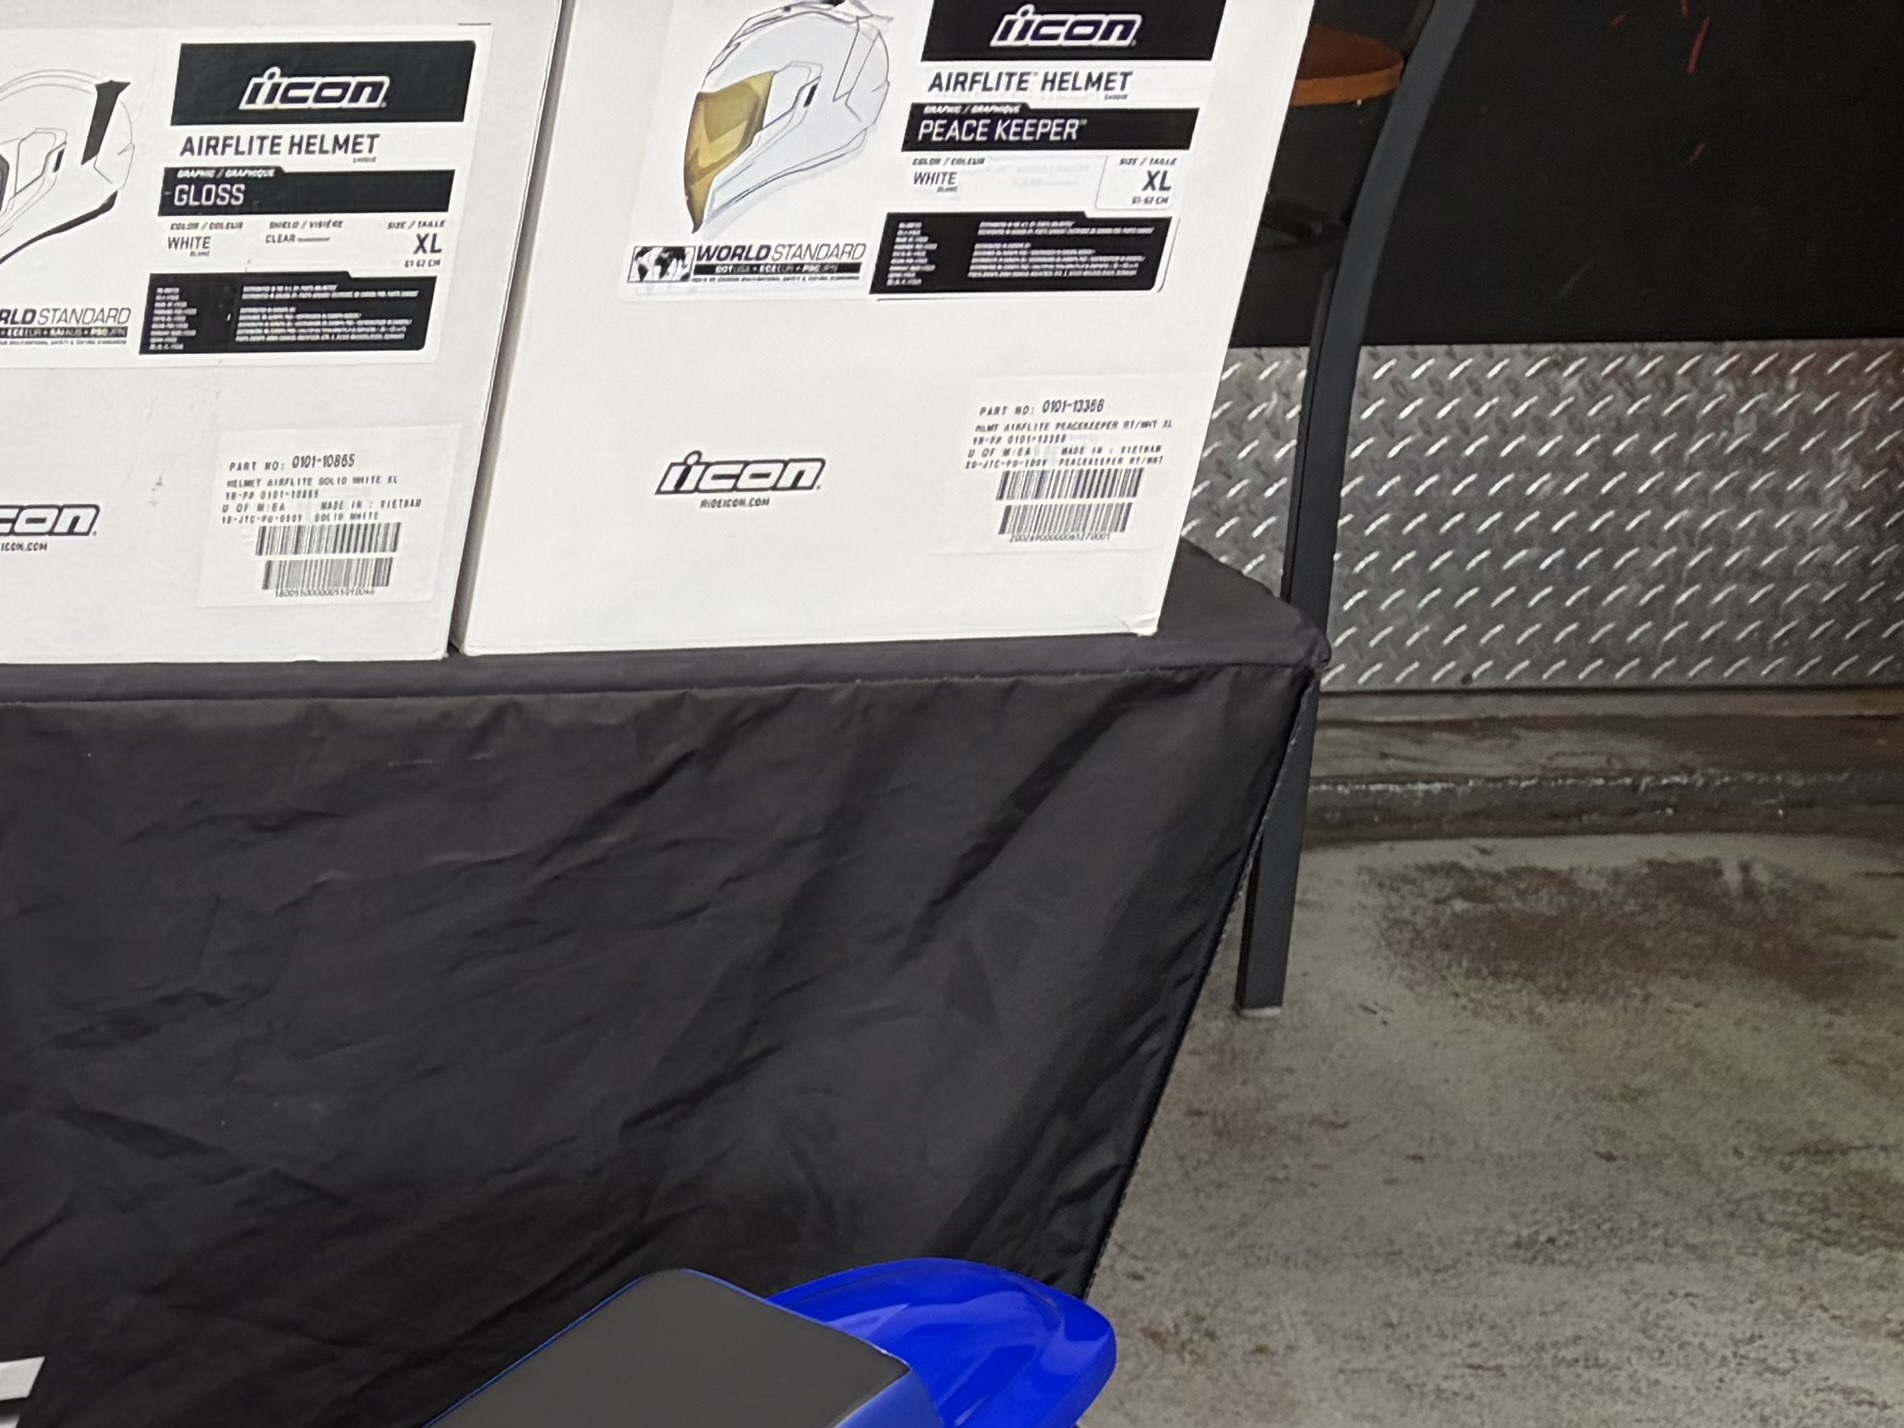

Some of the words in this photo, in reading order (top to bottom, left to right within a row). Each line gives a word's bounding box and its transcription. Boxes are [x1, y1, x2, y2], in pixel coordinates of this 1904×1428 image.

[1041, 70, 1133, 92] HELMET
[917, 119, 991, 142] PEACE
[180, 135, 283, 157] AIRFLITE
[288, 134, 380, 155] HELMET
[913, 171, 957, 186] WHITE
[1142, 170, 1172, 192] XL
[173, 184, 245, 206] GLOSS
[167, 236, 211, 250] WHITE
[265, 234, 296, 244] CLEAR
[413, 234, 443, 254] XL
[696, 244, 771, 262] WORLD
[771, 243, 867, 261] STANDARD
[38, 307, 131, 324] STANDARD
[979, 406, 1007, 416] PART
[229, 462, 256, 471] PART
[700, 498, 770, 509] RIDEICON.COM
